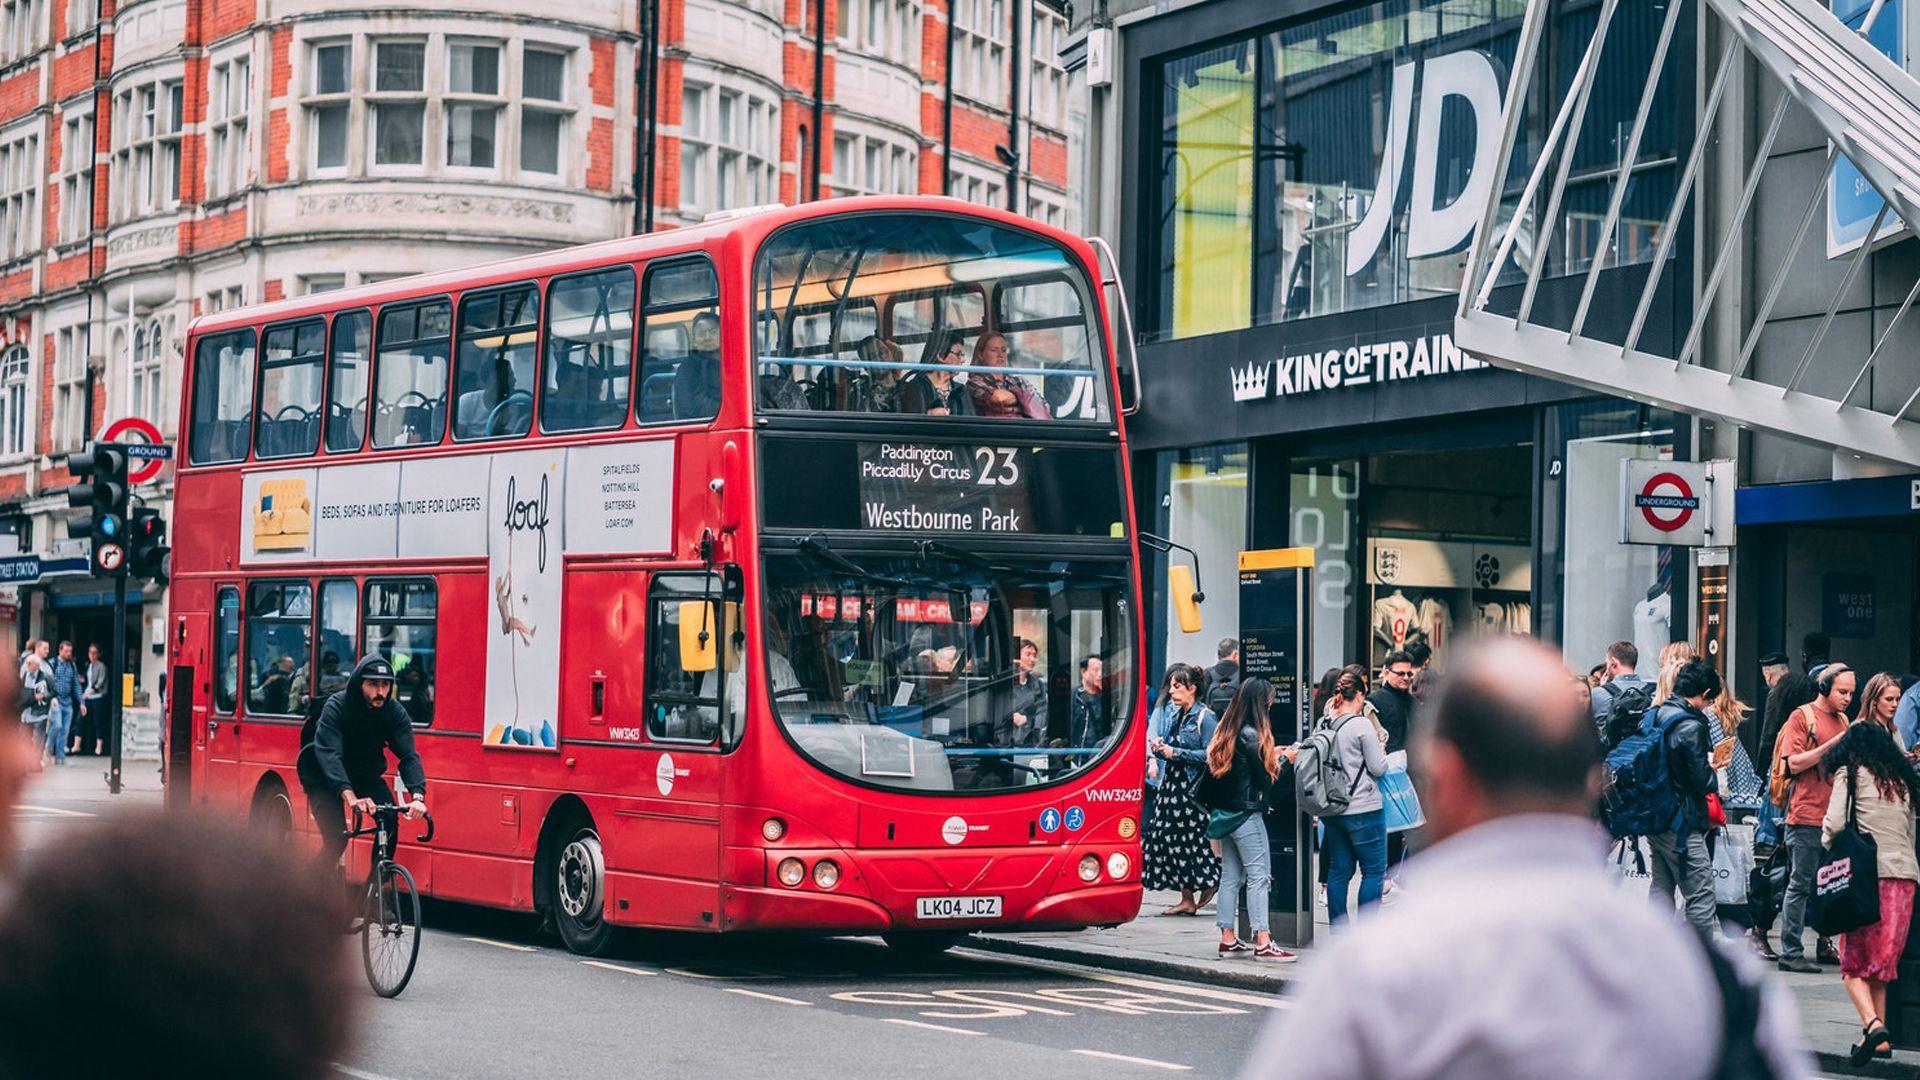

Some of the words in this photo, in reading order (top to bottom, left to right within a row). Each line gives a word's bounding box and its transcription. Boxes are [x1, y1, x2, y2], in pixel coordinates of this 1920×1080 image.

[1346, 50, 1501, 276] JD
[1276, 349, 1341, 396] KING
[1344, 345, 1373, 378] OF
[128, 446, 167, 457] GROUND
[881, 443, 953, 466] Paddington
[602, 464, 641, 476] SPITALFIELDS
[863, 461, 924, 483] Piccadilly
[929, 463, 971, 480] Circus
[975, 446, 1019, 486] 23
[1550, 460, 1562, 476] JD
[601, 483, 626, 493] NOTTING
[627, 482, 640, 492] HILL
[322, 505, 342, 520] BEDS,
[343, 504, 366, 518] SOFAS
[367, 503, 383, 517] AND
[384, 500, 426, 516] FURNITURE
[428, 499, 444, 513] FOR
[445, 497, 481, 513] LOAFERS
[604, 500, 636, 511] BATTERSEA
[1638, 499, 1696, 508] UNDERGROUND
[504, 472, 550, 574] loaf
[605, 518, 634, 528] LOAF.COM
[866, 502, 972, 530] Westbourne
[982, 507, 1020, 532] Park
[16, 561, 39, 577] STATION
[1838, 593, 1873, 606] west
[1847, 607, 1873, 619] one
[1394, 618, 1405, 643] 9
[1085, 789, 1142, 802] VNW32423
[923, 900, 962, 916] LK04
[966, 899, 996, 915] JCZ
